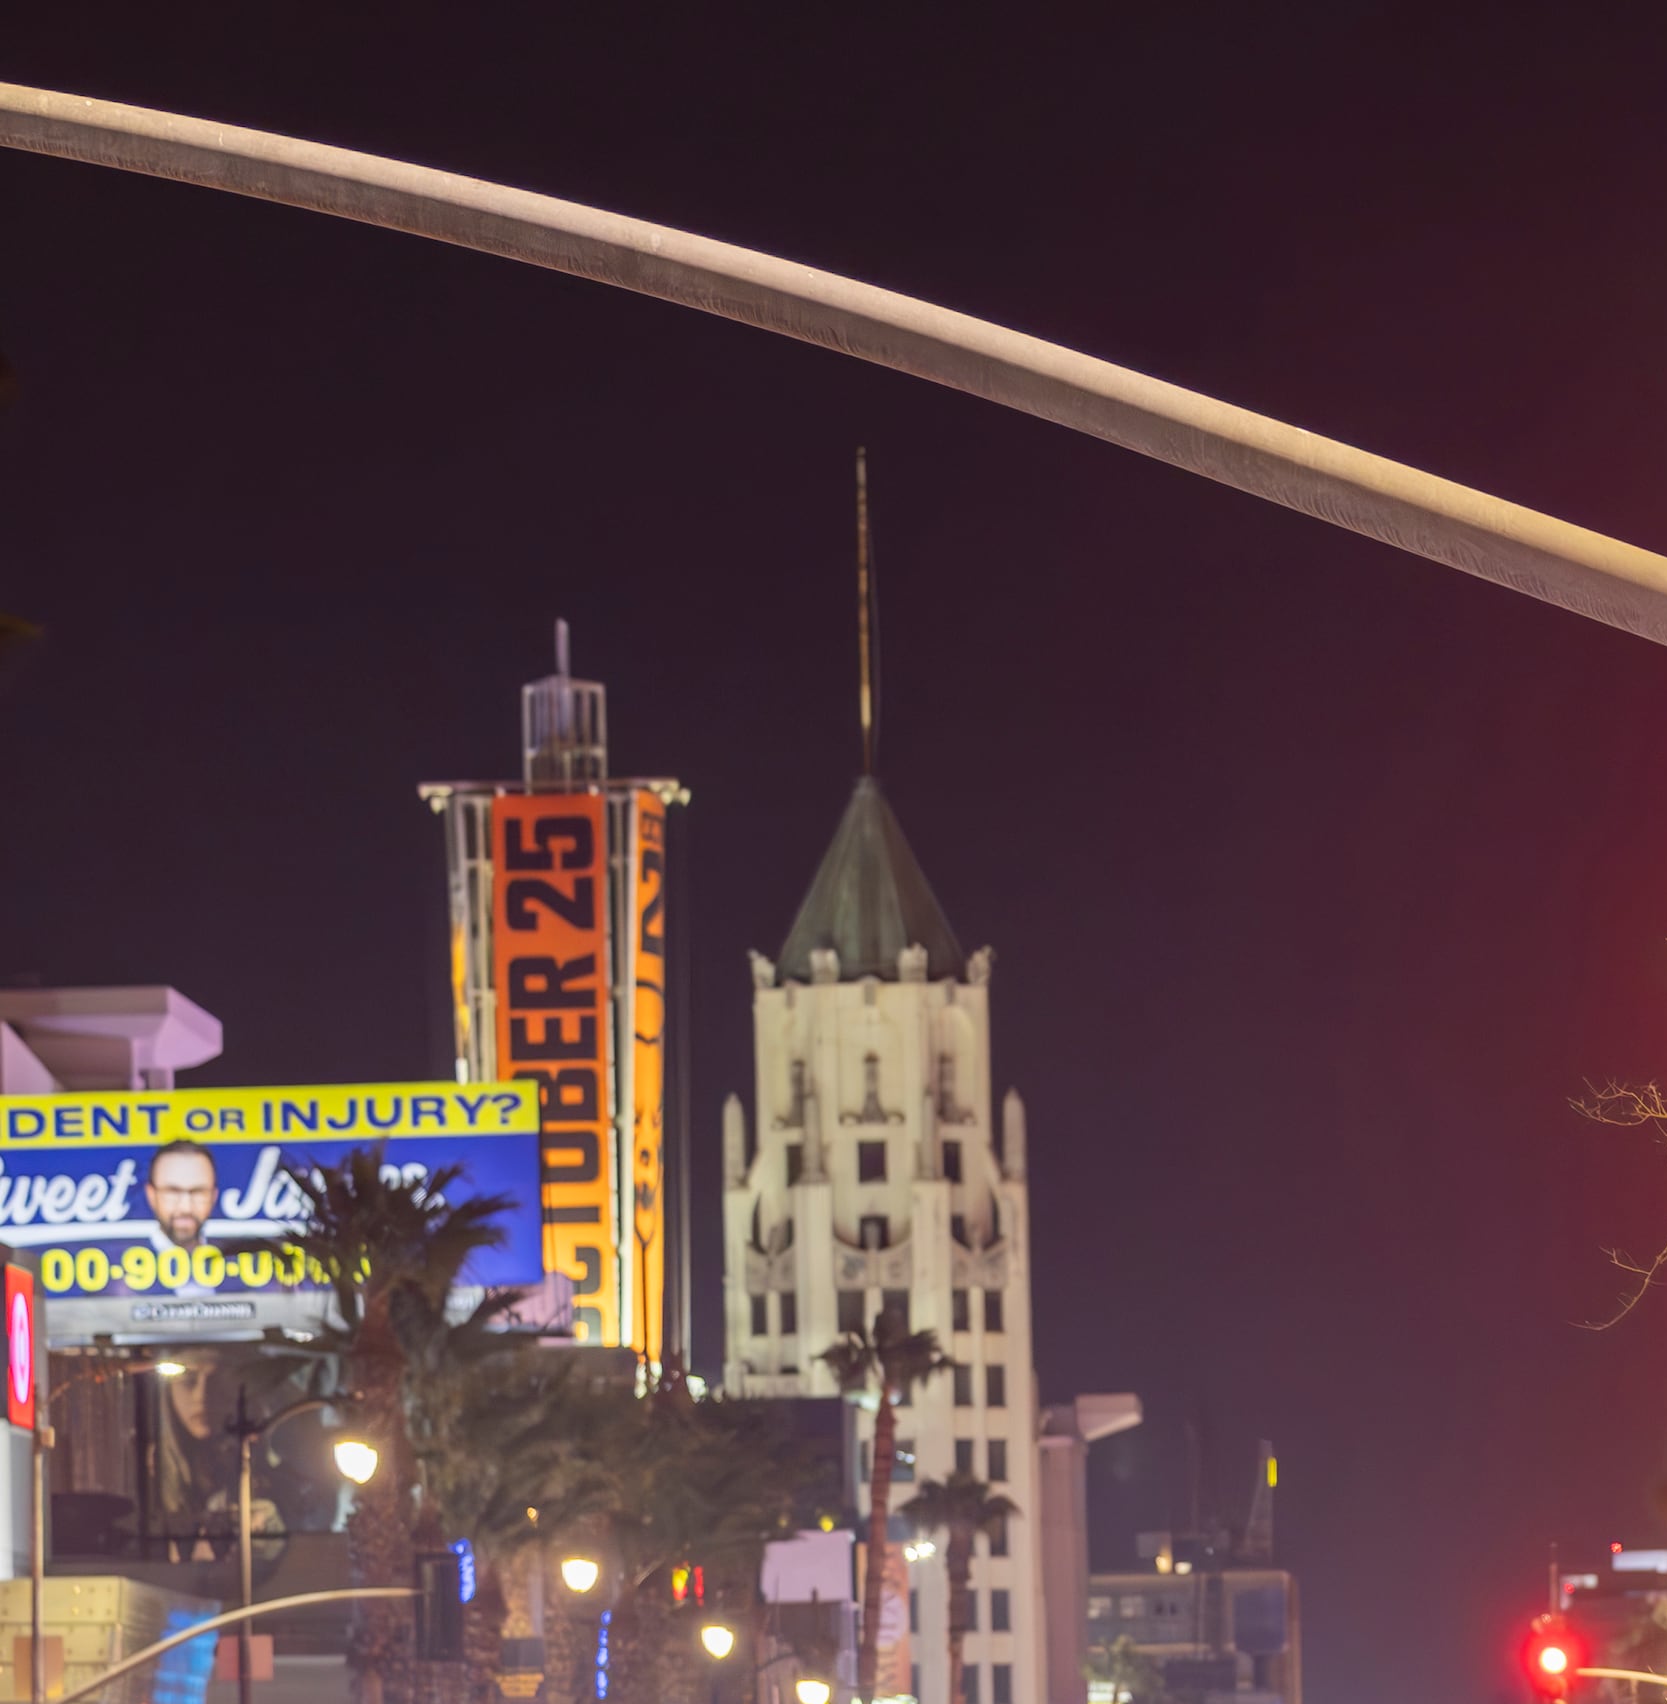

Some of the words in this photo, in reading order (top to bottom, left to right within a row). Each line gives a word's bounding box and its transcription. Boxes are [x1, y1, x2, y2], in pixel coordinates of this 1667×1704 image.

[503, 814, 597, 932] 25
[0, 1102, 170, 1139] DENT
[185, 1107, 246, 1133] OR
[262, 1092, 523, 1133] INJURY?
[0, 1155, 138, 1226] weet
